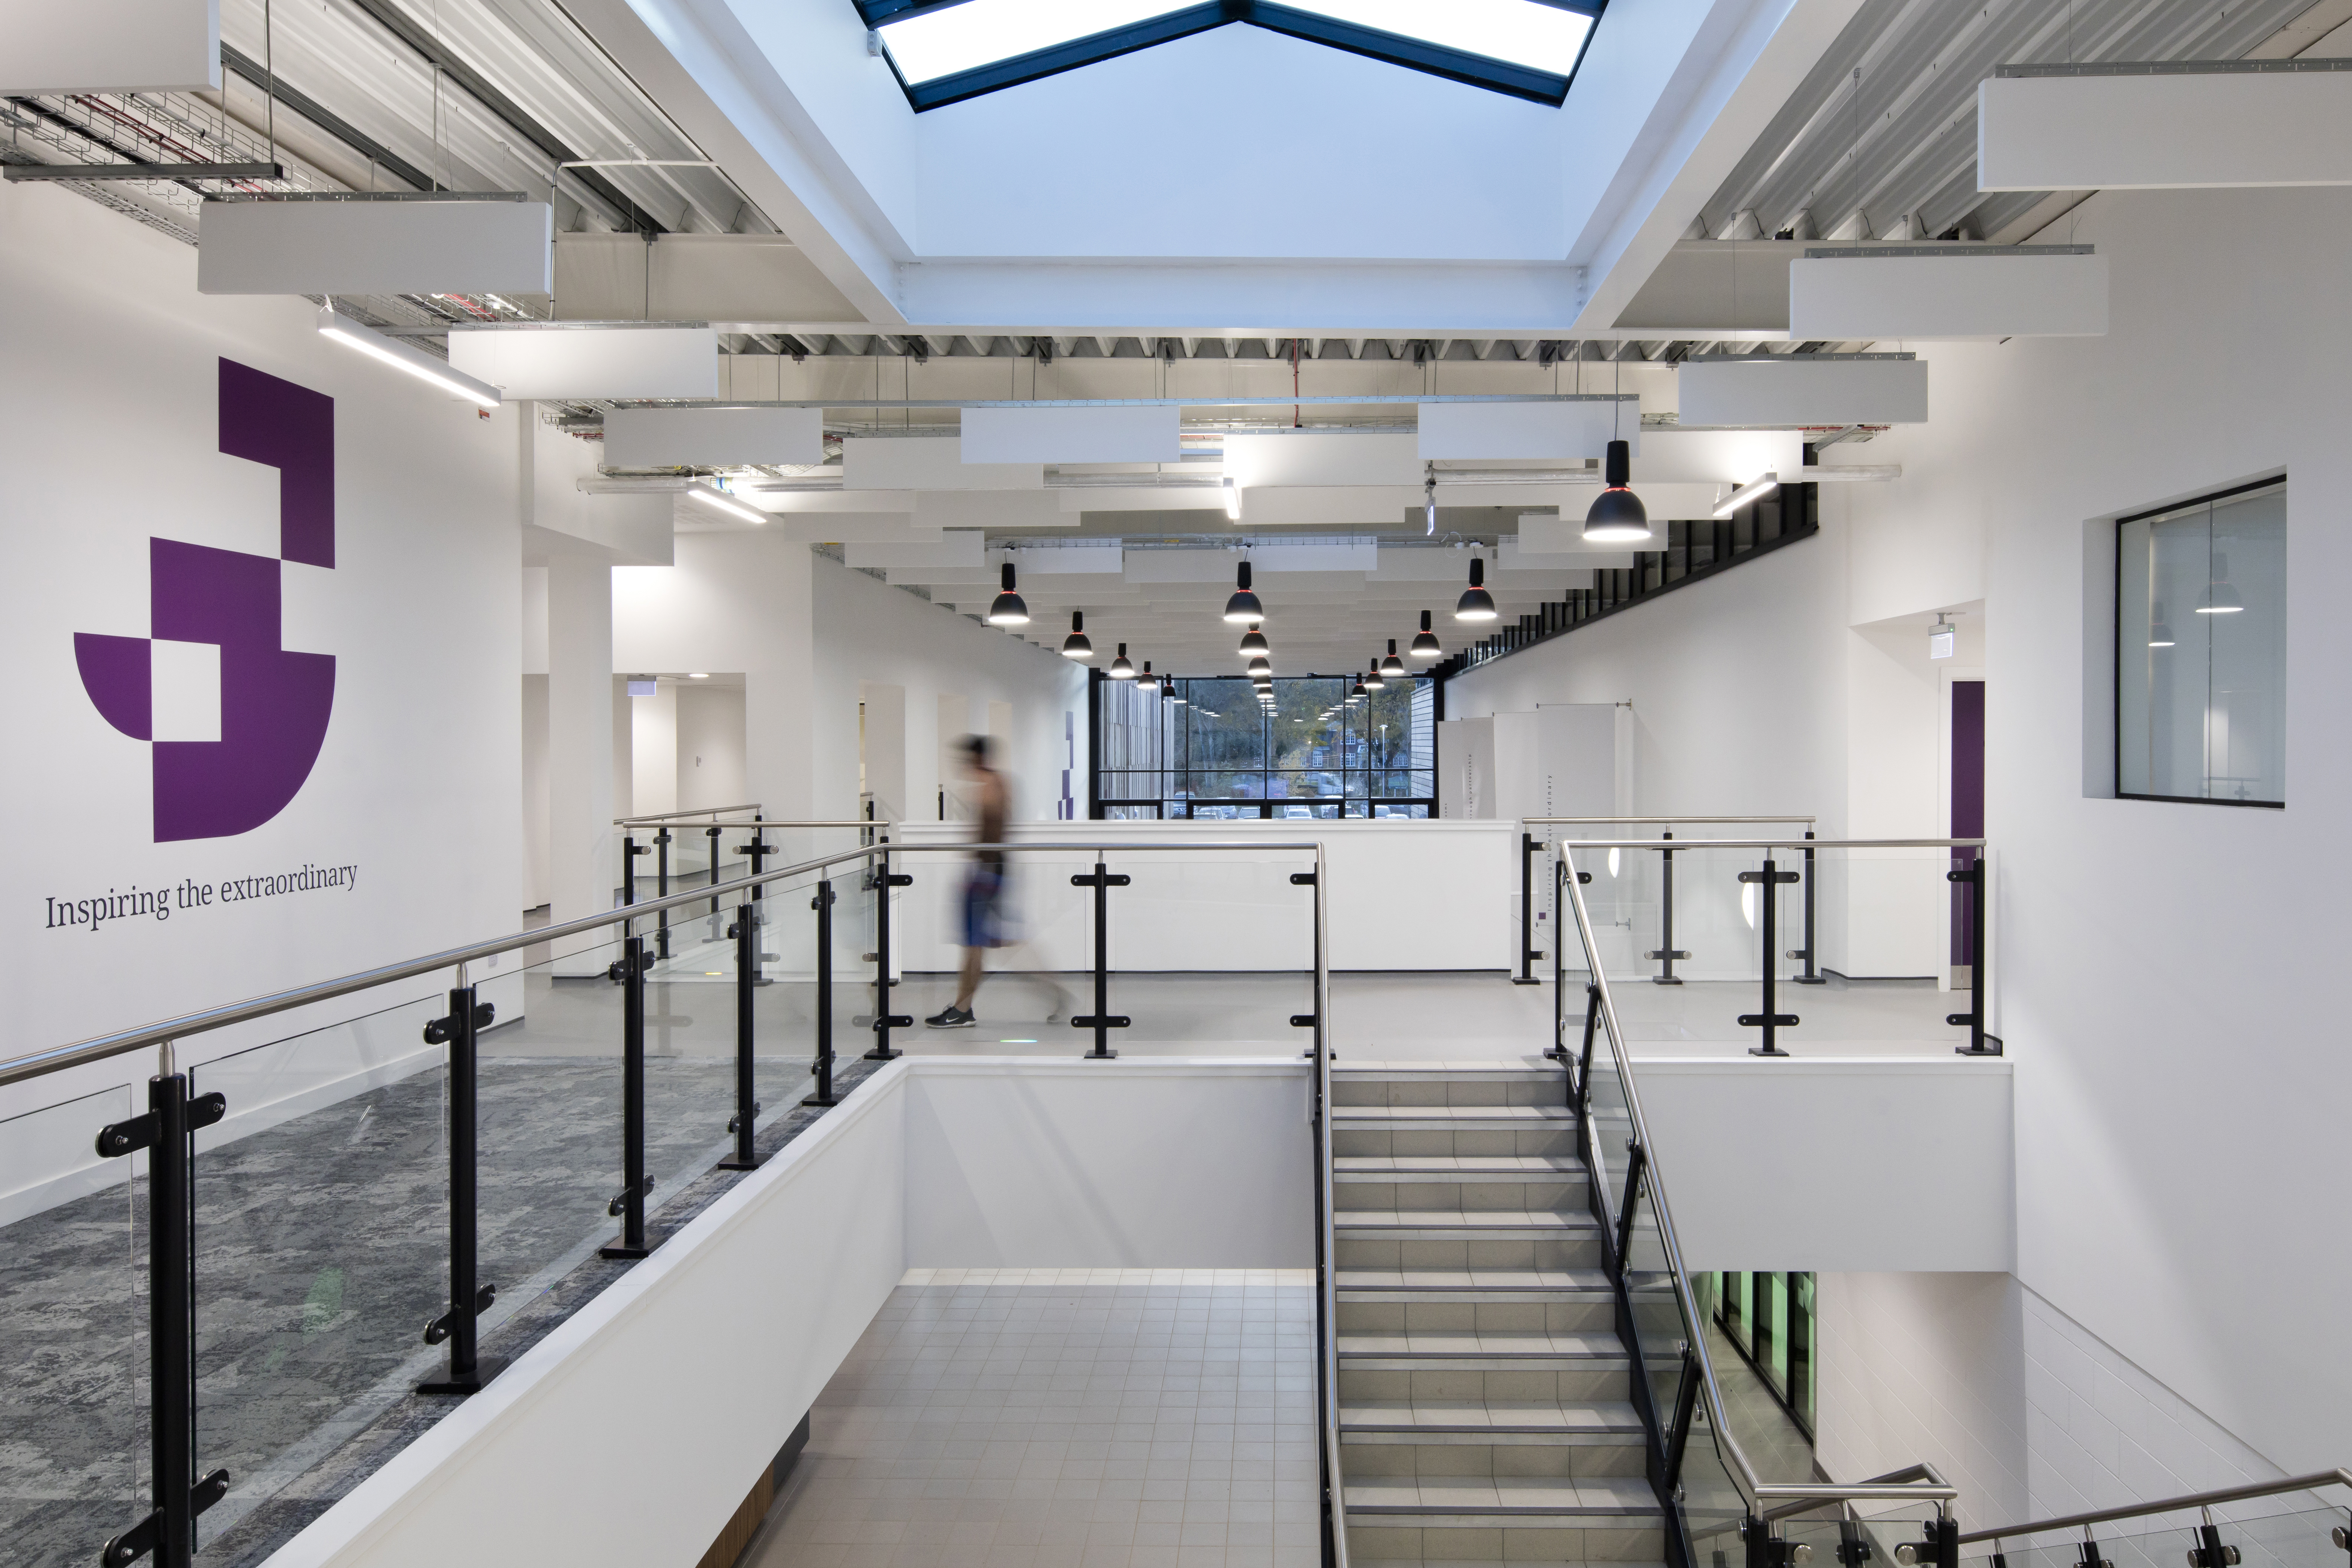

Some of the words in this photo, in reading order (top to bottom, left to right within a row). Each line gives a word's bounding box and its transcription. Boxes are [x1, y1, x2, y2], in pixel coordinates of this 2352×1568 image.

[45, 885, 170, 931] Inspiring
[177, 878, 213, 909] the
[221, 863, 357, 902] extraordinary
